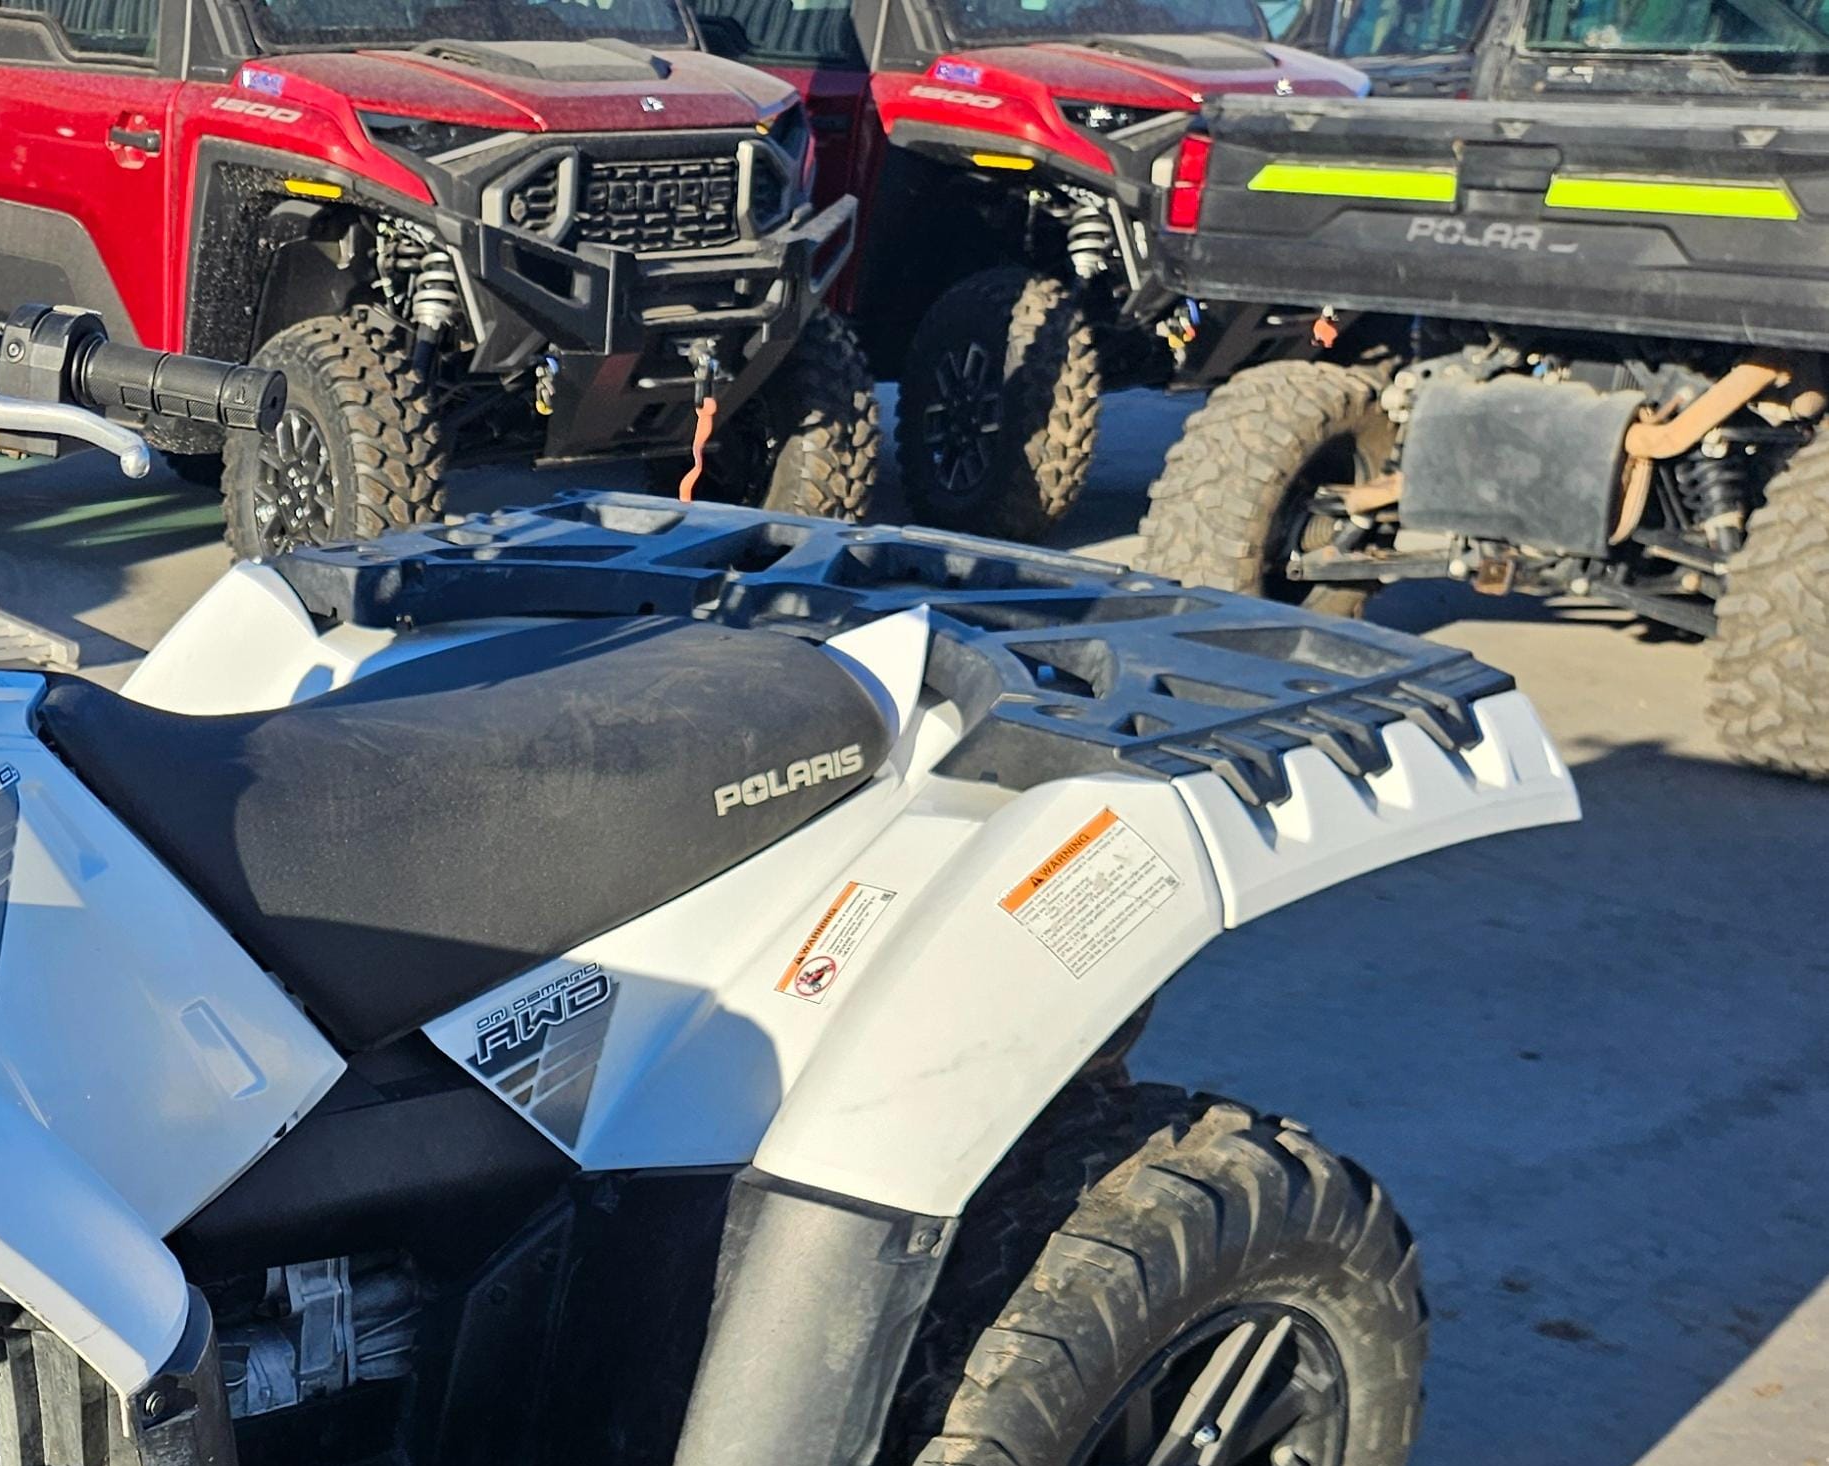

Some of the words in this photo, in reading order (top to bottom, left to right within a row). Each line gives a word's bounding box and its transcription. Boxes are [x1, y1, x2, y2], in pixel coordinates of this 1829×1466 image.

[587, 177, 733, 213] POLARIS
[1406, 216, 1578, 253] POLAR
[714, 743, 865, 816] POLARIS
[1041, 833, 1090, 877] WARNING
[476, 1008, 507, 1031] ON
[512, 961, 600, 1012] DEMAND
[476, 974, 611, 1065] AWD
